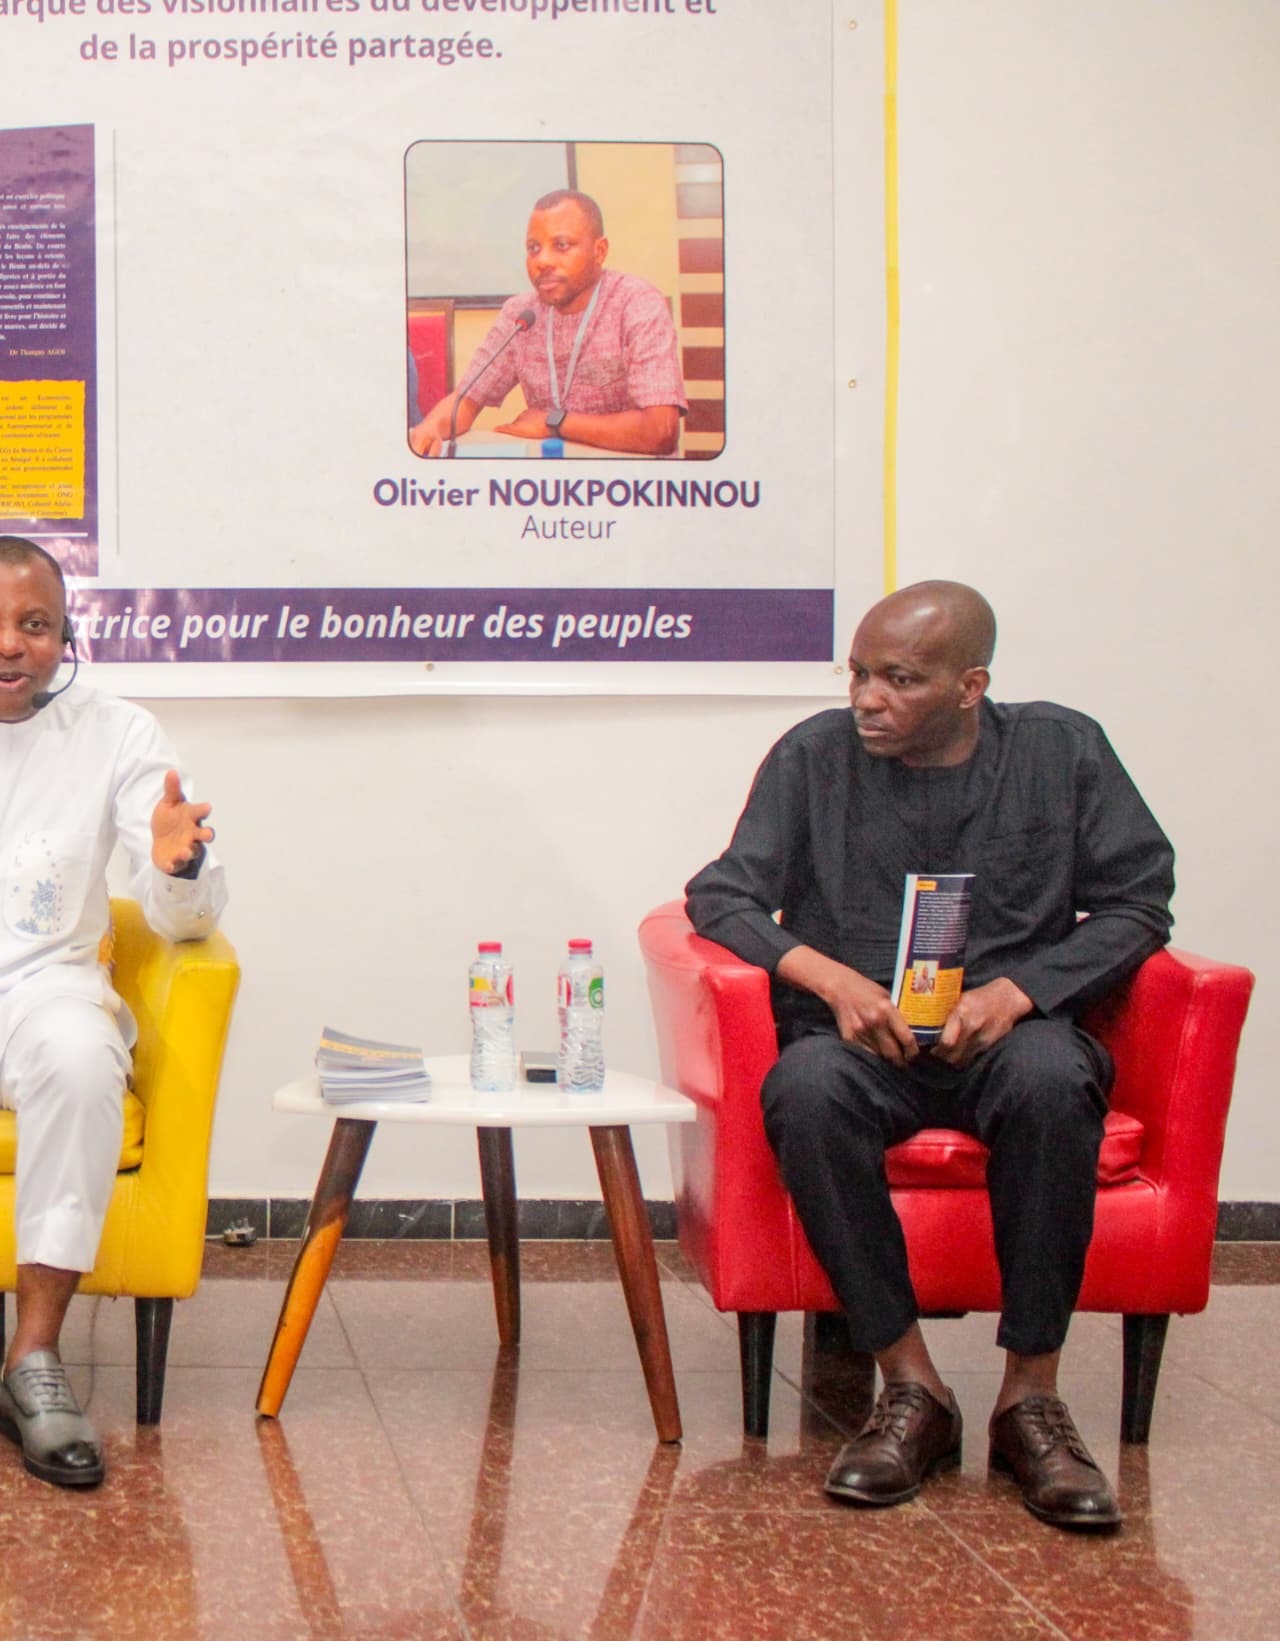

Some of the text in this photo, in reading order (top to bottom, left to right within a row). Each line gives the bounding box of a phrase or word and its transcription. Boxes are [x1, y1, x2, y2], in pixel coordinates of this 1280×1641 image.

[80, 31, 502, 67] de la prospérité partagée.
[374, 478, 760, 508] Olivier NOUKPOKINNOU
[521, 515, 616, 539] Auteur
[180, 615, 266, 648] pour
[276, 606, 309, 638] le
[320, 606, 476, 638] bonheur
[483, 606, 544, 638] des
[553, 606, 692, 647] peuples
